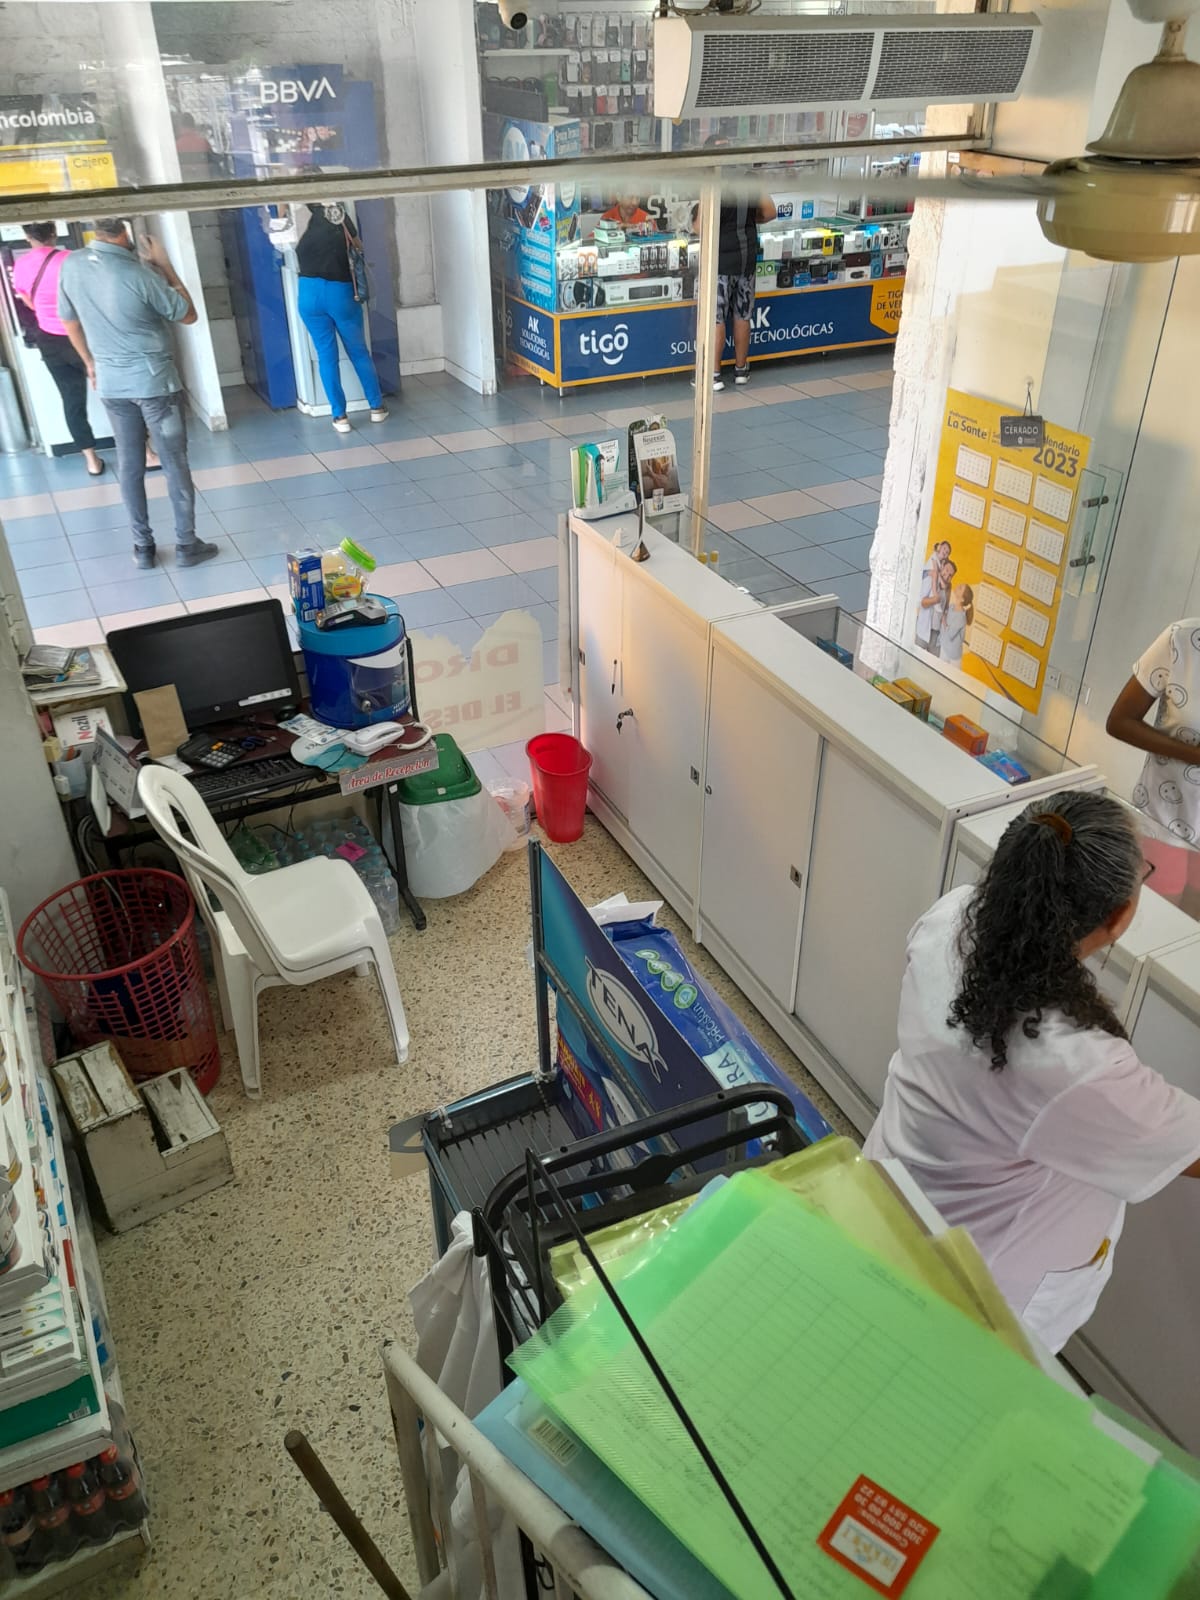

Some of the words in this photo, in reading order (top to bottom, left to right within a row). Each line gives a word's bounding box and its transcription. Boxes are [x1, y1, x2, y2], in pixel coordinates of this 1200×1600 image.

[260, 76, 337, 104] BBVA
[73, 156, 109, 169] Cajero
[888, 290, 904, 299] TIG
[877, 302, 888, 311] DE
[889, 299, 903, 309] VE
[528, 315, 539, 334] AK
[580, 323, 629, 360] tigo
[947, 415, 959, 429] La
[1004, 426, 1039, 435] CERRADO
[1033, 448, 1079, 478] 2023
[372, 769, 383, 781] de
[585, 956, 662, 1084] TENA
